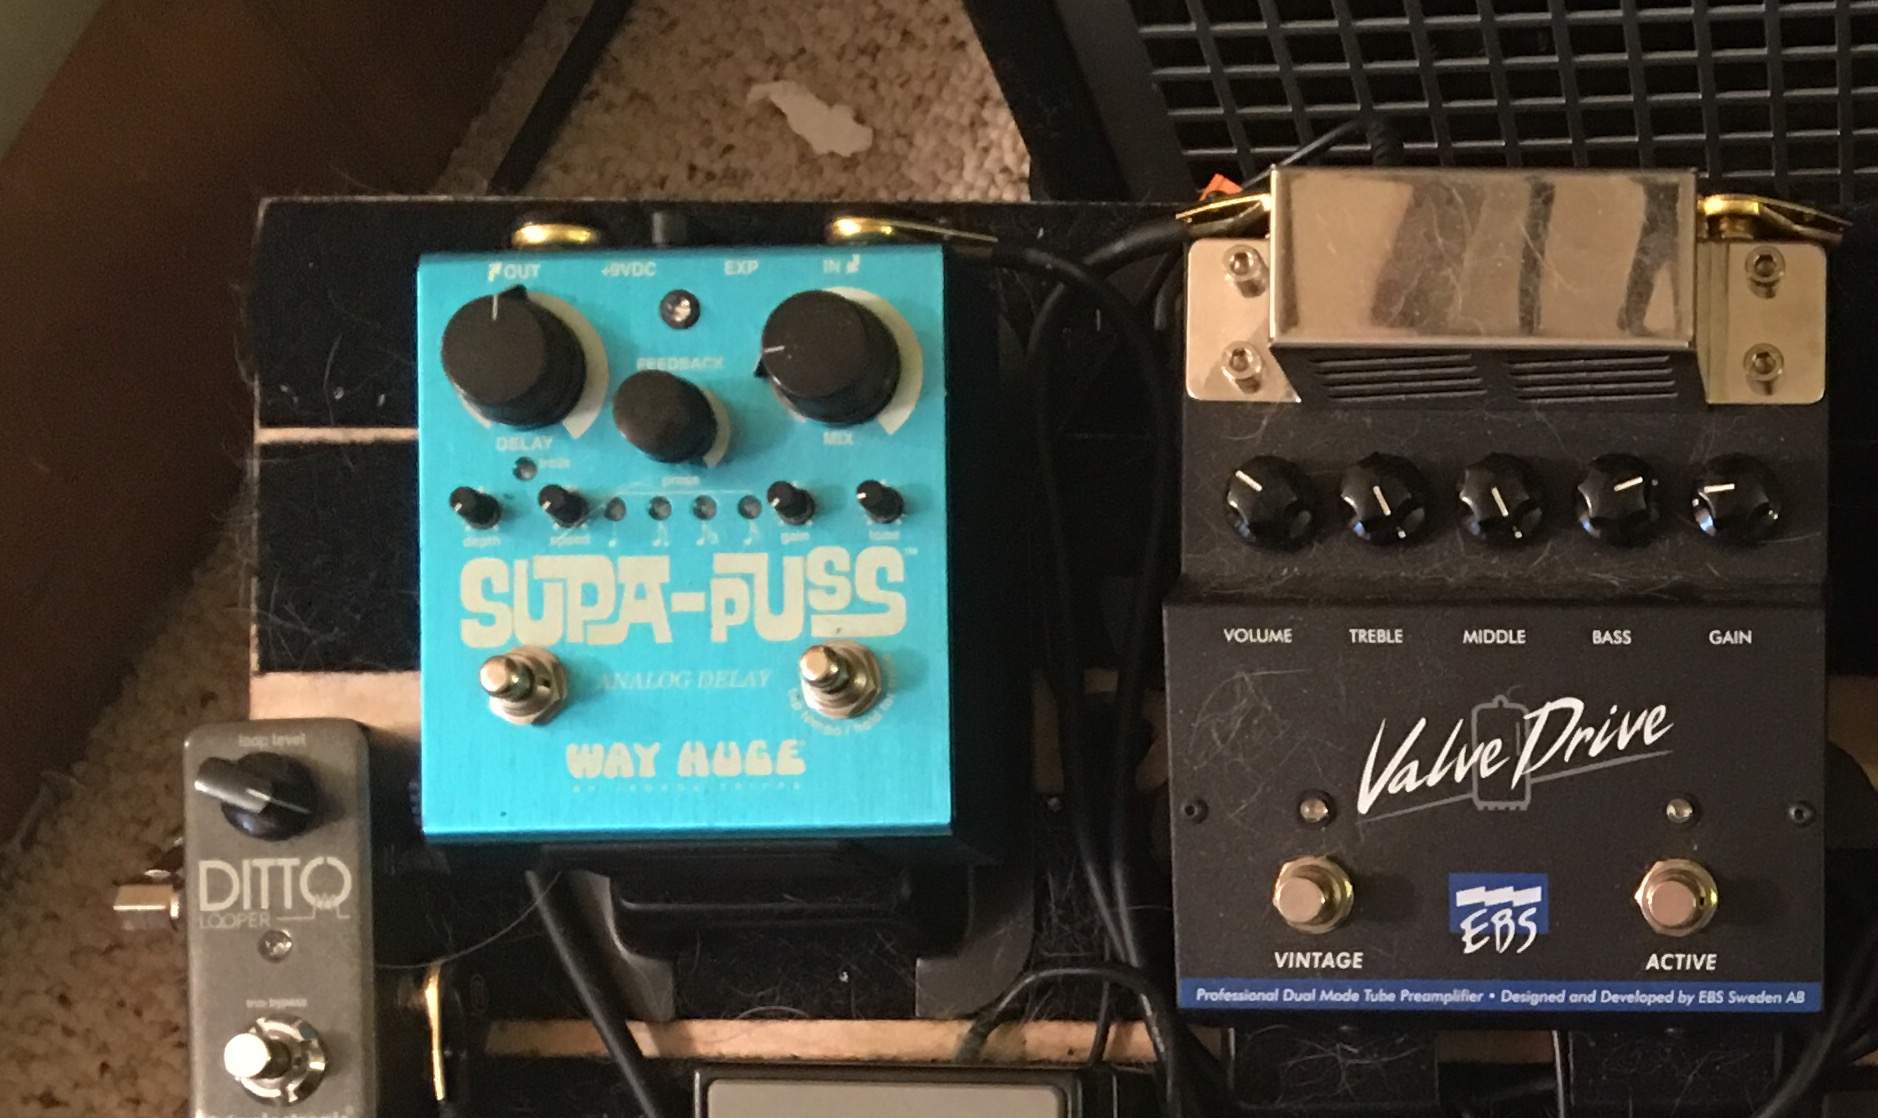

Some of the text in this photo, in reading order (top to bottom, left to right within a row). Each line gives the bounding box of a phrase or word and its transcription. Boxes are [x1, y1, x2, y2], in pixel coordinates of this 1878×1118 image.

[505, 265, 540, 279] OUT
[724, 261, 758, 275] EXP
[823, 260, 840, 275] IN
[496, 437, 553, 452] DELAY
[823, 433, 852, 447] MIX
[1223, 628, 1292, 644] VOLUME
[1349, 629, 1403, 644] TREBLE
[1462, 629, 1527, 644] MIDDLE
[1592, 629, 1632, 645] BASS
[1708, 630, 1752, 645] GAIN
[599, 669, 771, 691] ANALOG DELAY
[566, 739, 806, 778] WAY HUGE
[1357, 697, 1675, 815] Valve Drive
[199, 856, 352, 911] DITTO
[201, 912, 270, 928] LOOPER
[1461, 907, 1538, 956] EBS
[1274, 951, 1364, 969] VINTAGE
[1646, 954, 1717, 971] ACTIVE
[1196, 988, 1805, 1006] Professional Dual Mode Tube Preamplifier Designed and Developed by EBS Sweden AB
